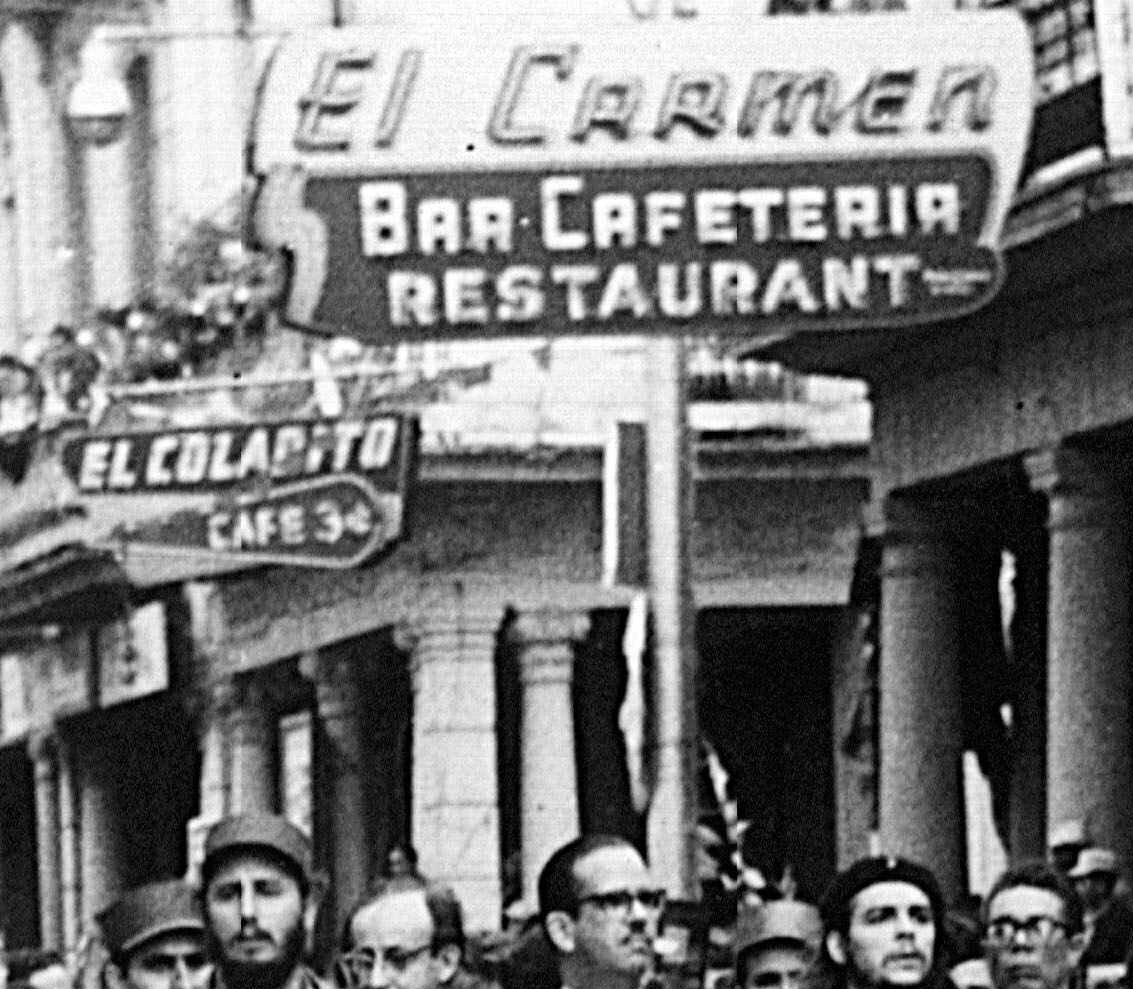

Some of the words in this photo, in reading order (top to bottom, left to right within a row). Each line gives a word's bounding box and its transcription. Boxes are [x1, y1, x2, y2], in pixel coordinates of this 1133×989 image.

[292, 48, 424, 154] El
[541, 175, 960, 250] CAFETERIA
[387, 254, 922, 326] RESTAURANT
[79, 438, 137, 488] EL
[207, 505, 306, 550] CAFE
